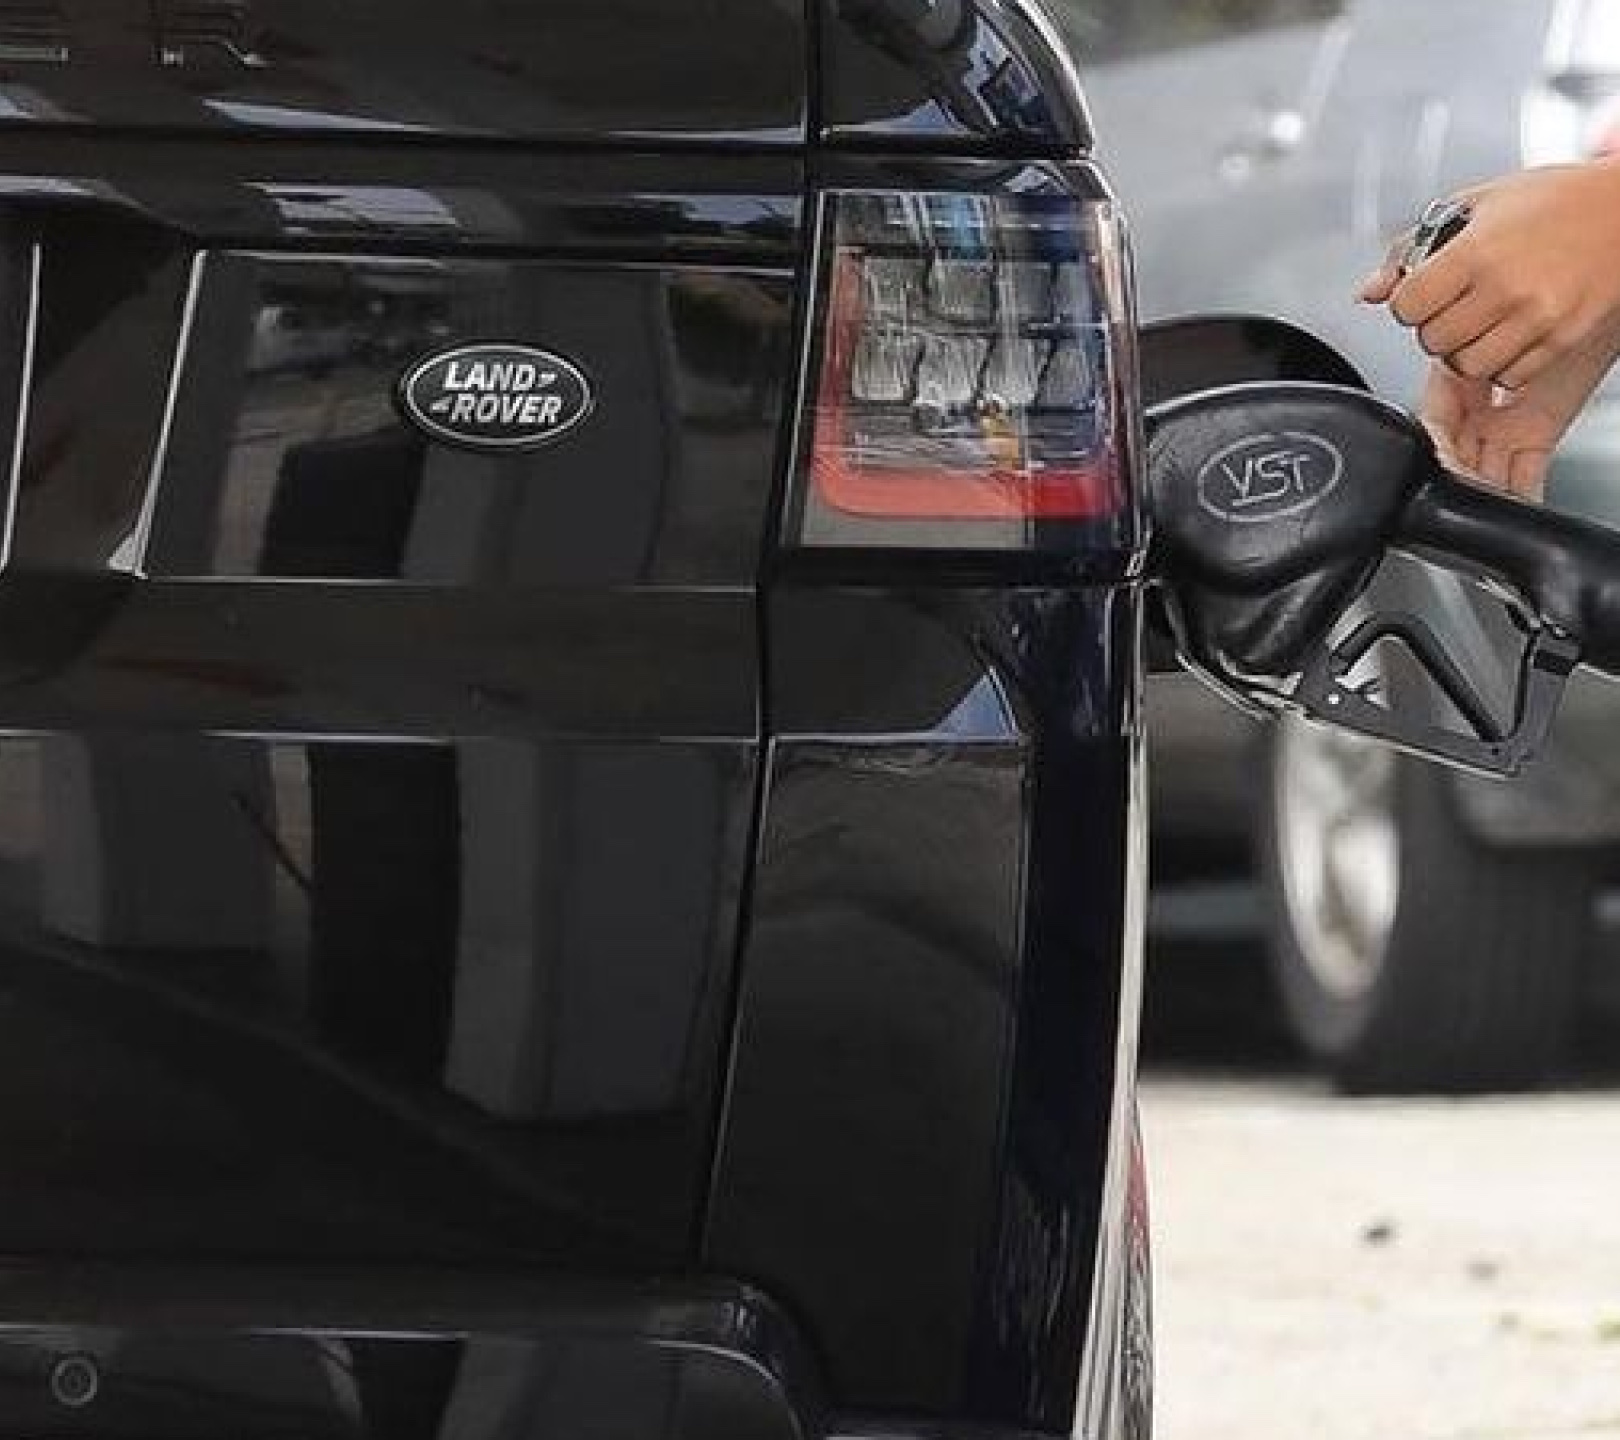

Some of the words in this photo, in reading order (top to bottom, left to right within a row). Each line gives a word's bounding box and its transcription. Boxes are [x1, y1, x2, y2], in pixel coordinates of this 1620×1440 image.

[444, 360, 536, 391] LAND
[450, 392, 562, 424] ROVER
[1220, 449, 1311, 507] VST
